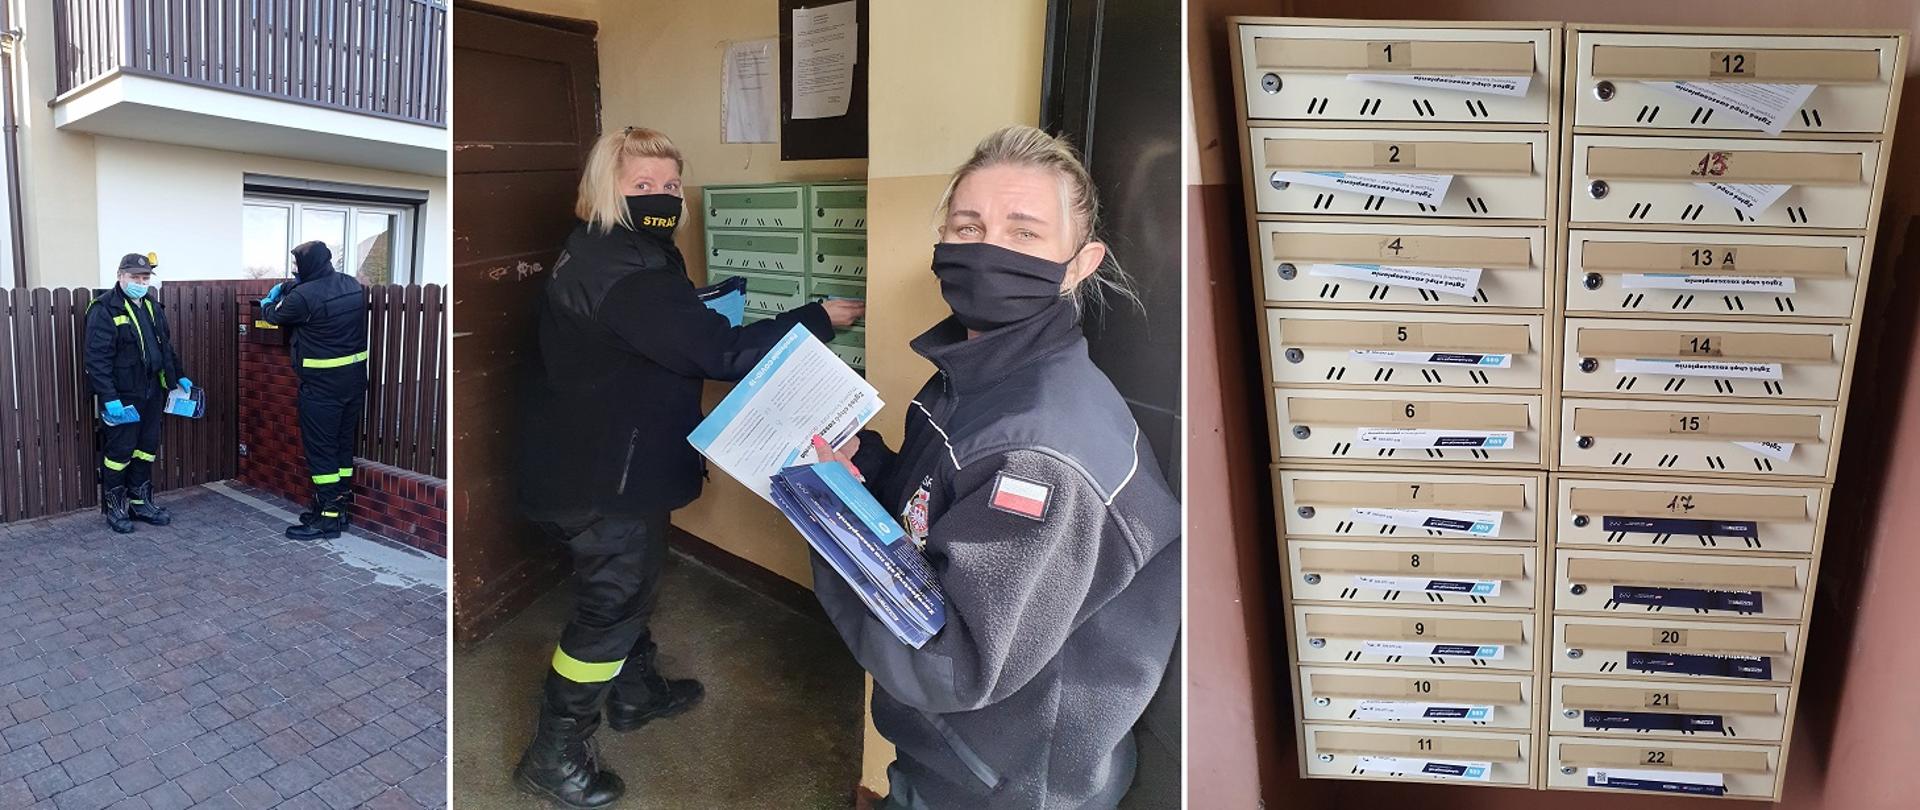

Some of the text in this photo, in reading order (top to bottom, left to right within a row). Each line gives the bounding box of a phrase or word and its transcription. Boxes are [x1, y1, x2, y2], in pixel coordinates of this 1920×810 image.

[1382, 43, 1392, 64] 1
[1721, 54, 1745, 74] 12
[1387, 144, 1401, 164] 2
[1387, 236, 1404, 256] 4
[1691, 249, 1734, 266] 13 A
[1396, 325, 1408, 342] 5
[1689, 336, 1711, 354] 14
[1404, 403, 1416, 419] 6
[1678, 415, 1701, 431] 15
[1409, 484, 1421, 500] 7
[1410, 553, 1421, 569] 8
[1414, 622, 1425, 636] 9
[1659, 630, 1681, 645] 20
[1412, 680, 1432, 694] 10
[1652, 693, 1670, 707] 21
[1417, 738, 1433, 751] 11
[1647, 750, 1666, 764] 22
